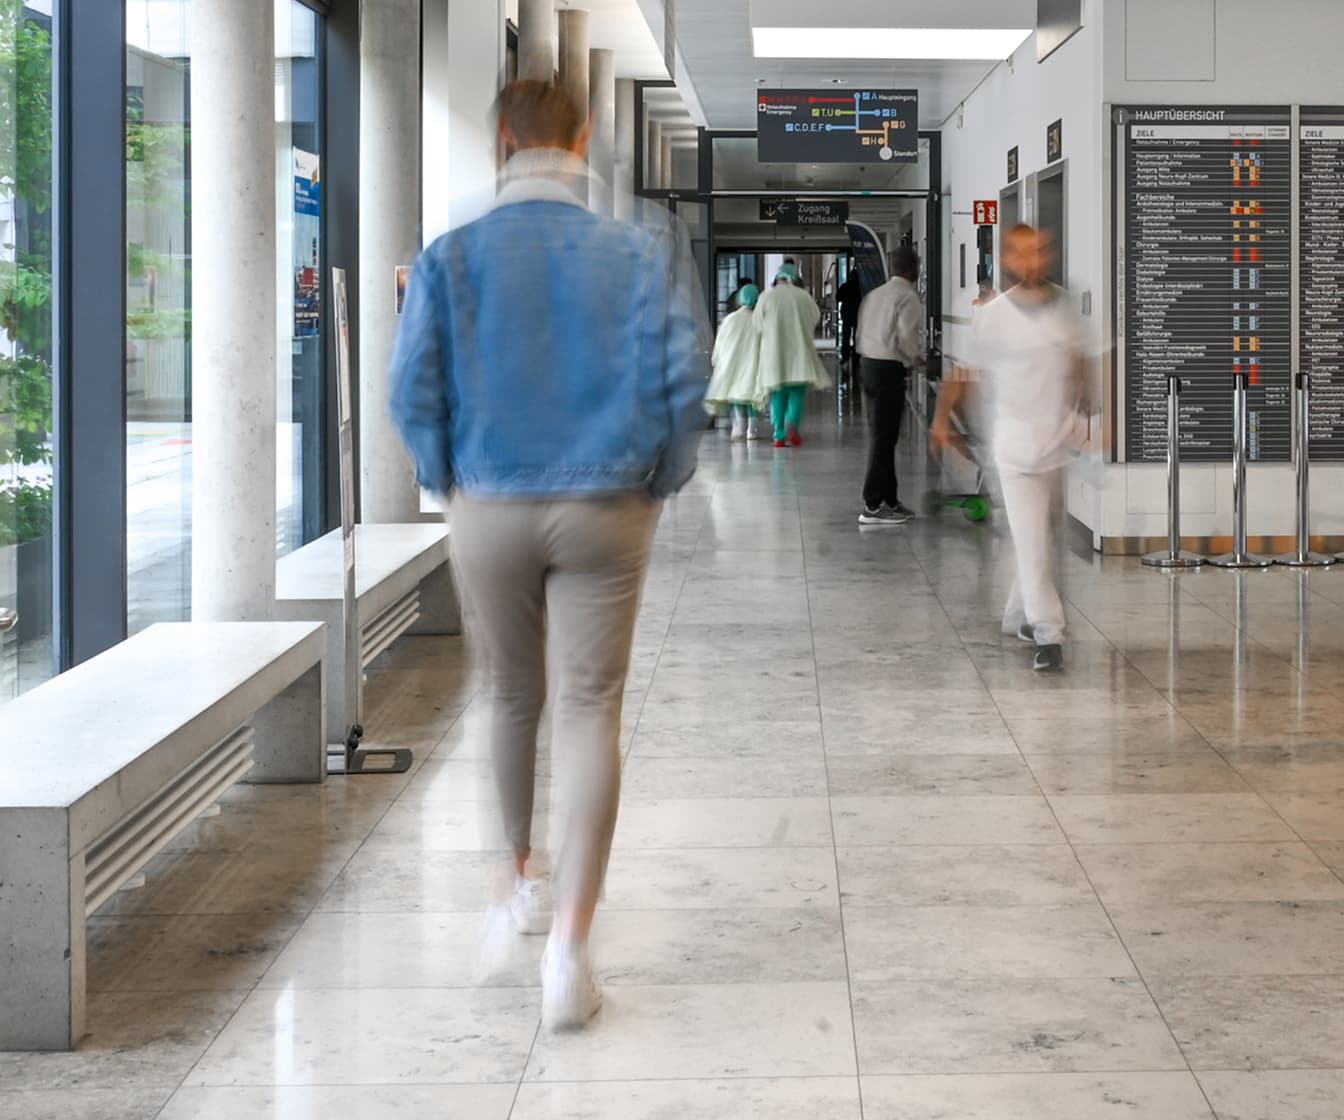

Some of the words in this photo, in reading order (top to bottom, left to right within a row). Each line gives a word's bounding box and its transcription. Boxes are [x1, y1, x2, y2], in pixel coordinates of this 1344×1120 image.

[890, 109, 896, 117] B
[1136, 108, 1225, 120] HAUPTÜBERSICHT
[798, 204, 830, 215] Zugang
[798, 214, 839, 224] Kreißsaal
